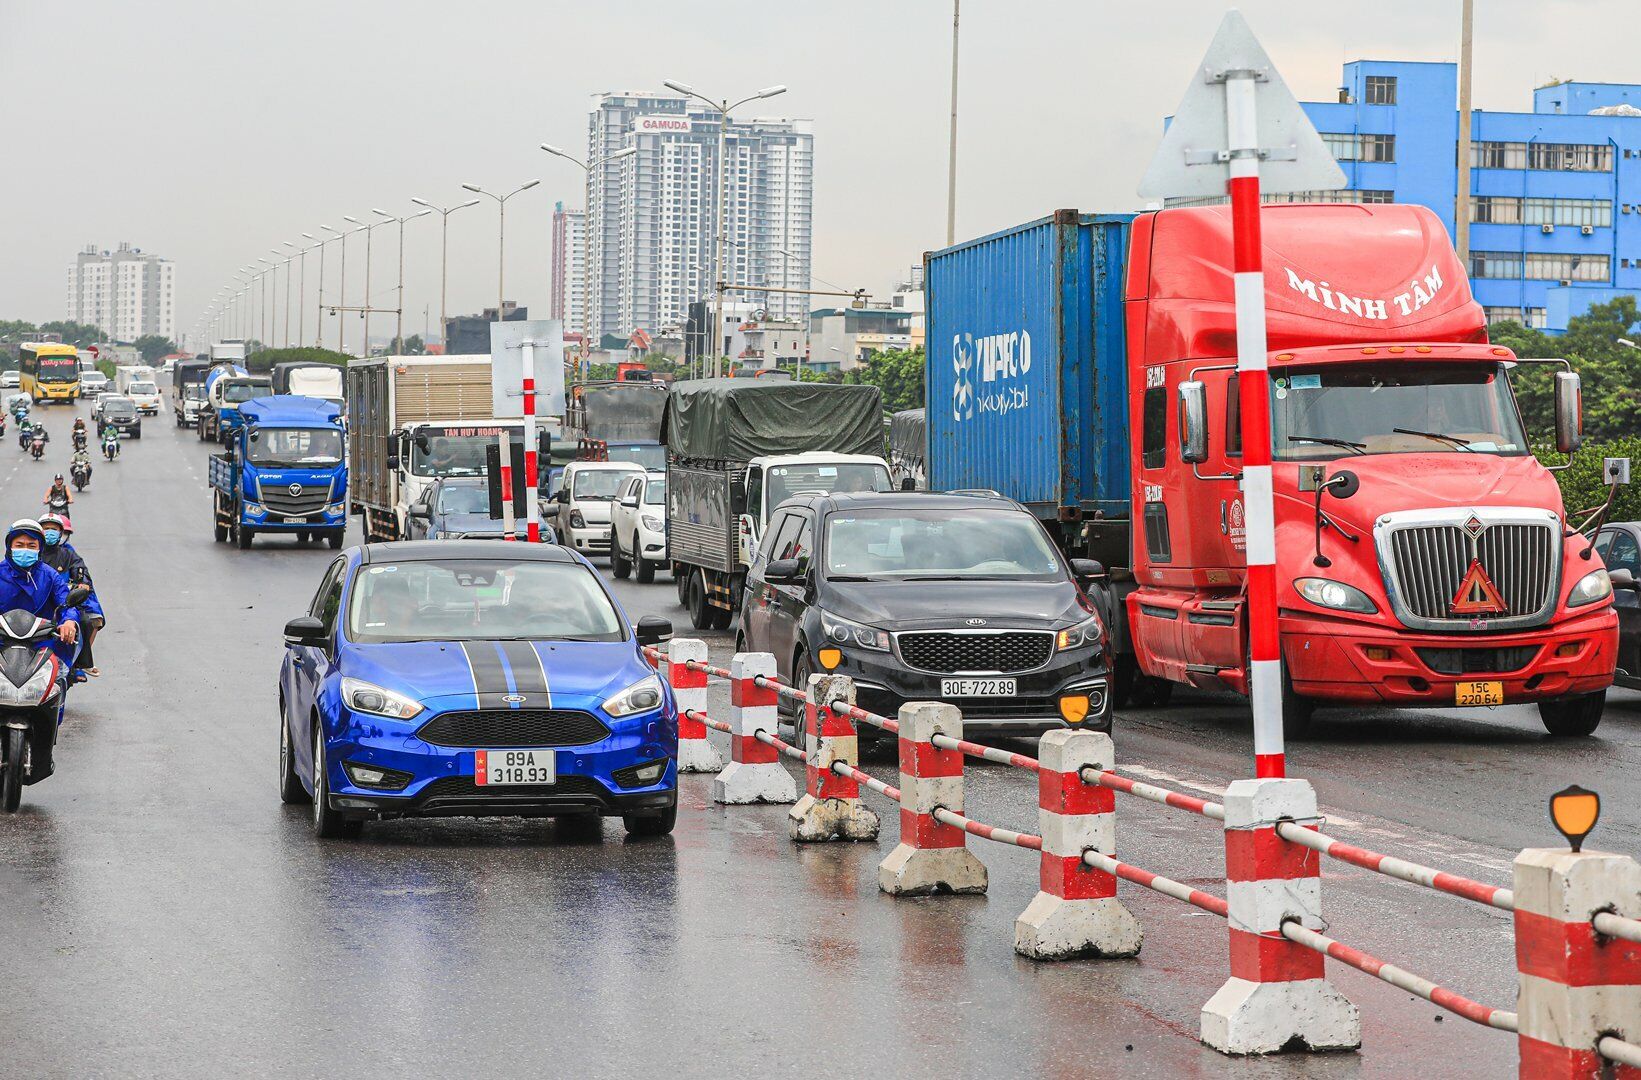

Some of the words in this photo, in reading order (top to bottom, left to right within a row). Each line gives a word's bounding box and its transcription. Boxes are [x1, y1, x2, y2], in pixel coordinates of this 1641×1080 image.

[643, 120, 688, 129] GAMUDA
[1394, 264, 1443, 316] TÂM
[460, 428, 475, 437] HUY
[944, 681, 1014, 695] 30E-722.89
[1471, 683, 1489, 693] 15C
[1461, 694, 1498, 705] 220.64
[506, 752, 535, 766] 89A
[494, 768, 547, 782] 318.93
